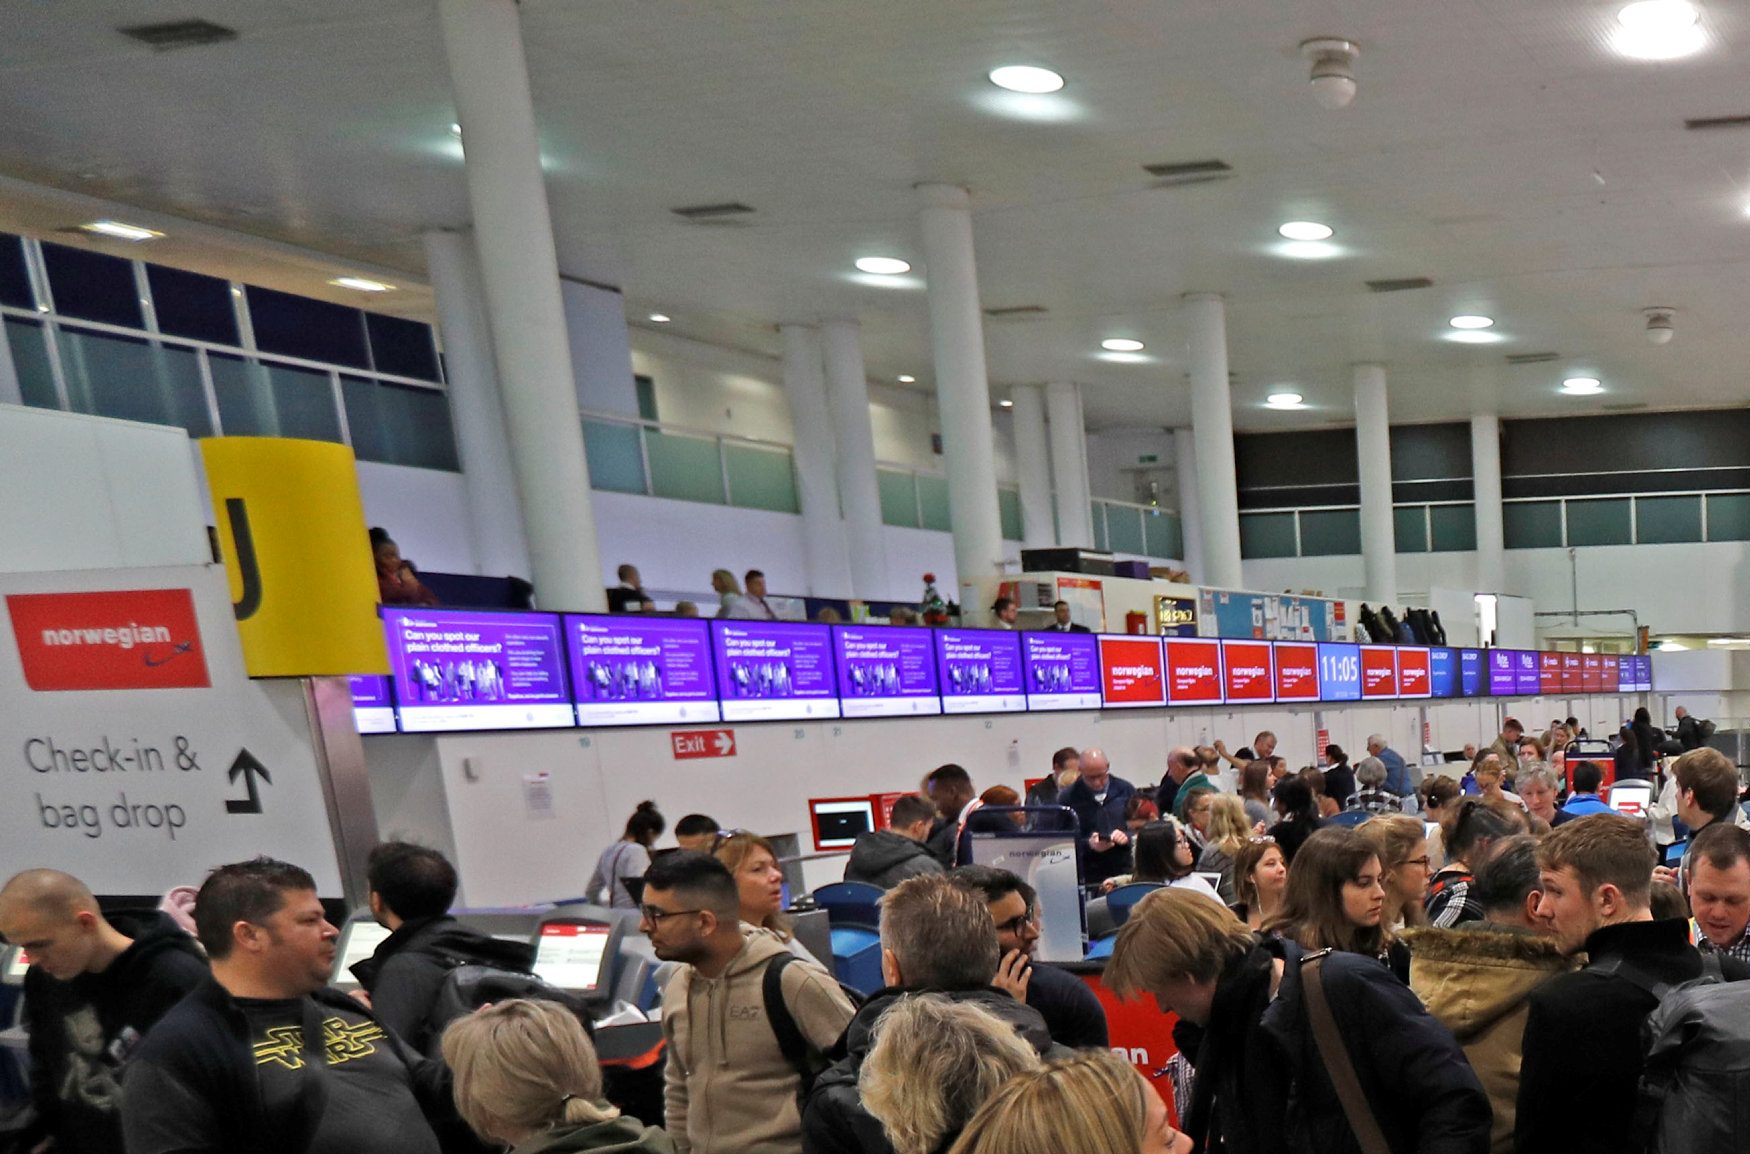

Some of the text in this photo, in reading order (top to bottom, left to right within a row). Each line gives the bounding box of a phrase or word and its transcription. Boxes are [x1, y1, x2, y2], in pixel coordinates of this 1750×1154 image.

[225, 498, 262, 620] J
[42, 622, 171, 649] norwegian
[1112, 665, 1154, 678] norwegian
[1321, 655, 1358, 682] 11:05
[25, 734, 202, 774] Check-in &
[674, 734, 707, 754] Exit
[37, 791, 187, 840] bag drop
[1009, 850, 1062, 858] norwegian
[253, 1017, 384, 1057] STR
